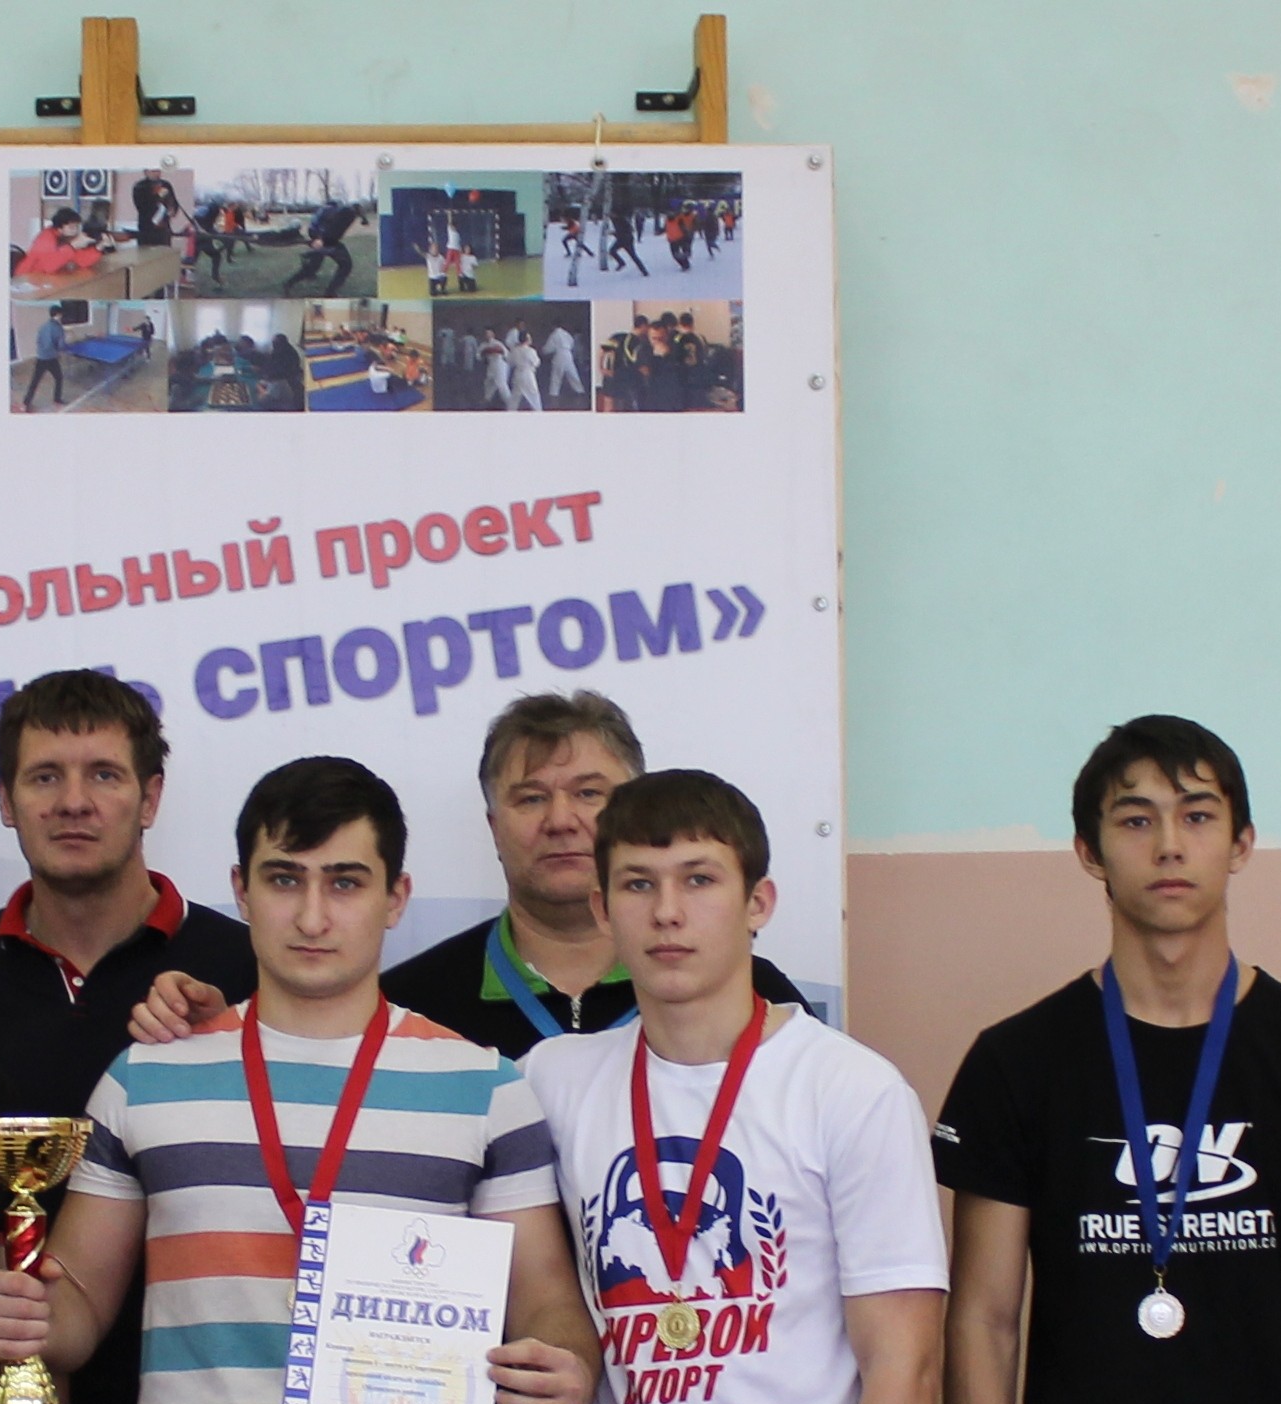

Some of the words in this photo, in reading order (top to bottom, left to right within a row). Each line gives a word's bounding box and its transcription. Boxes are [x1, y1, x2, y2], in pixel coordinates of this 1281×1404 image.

[316, 491, 601, 589] проект
[194, 582, 766, 720] спортом»
[330, 1291, 491, 1333] ДИПЛОМ
